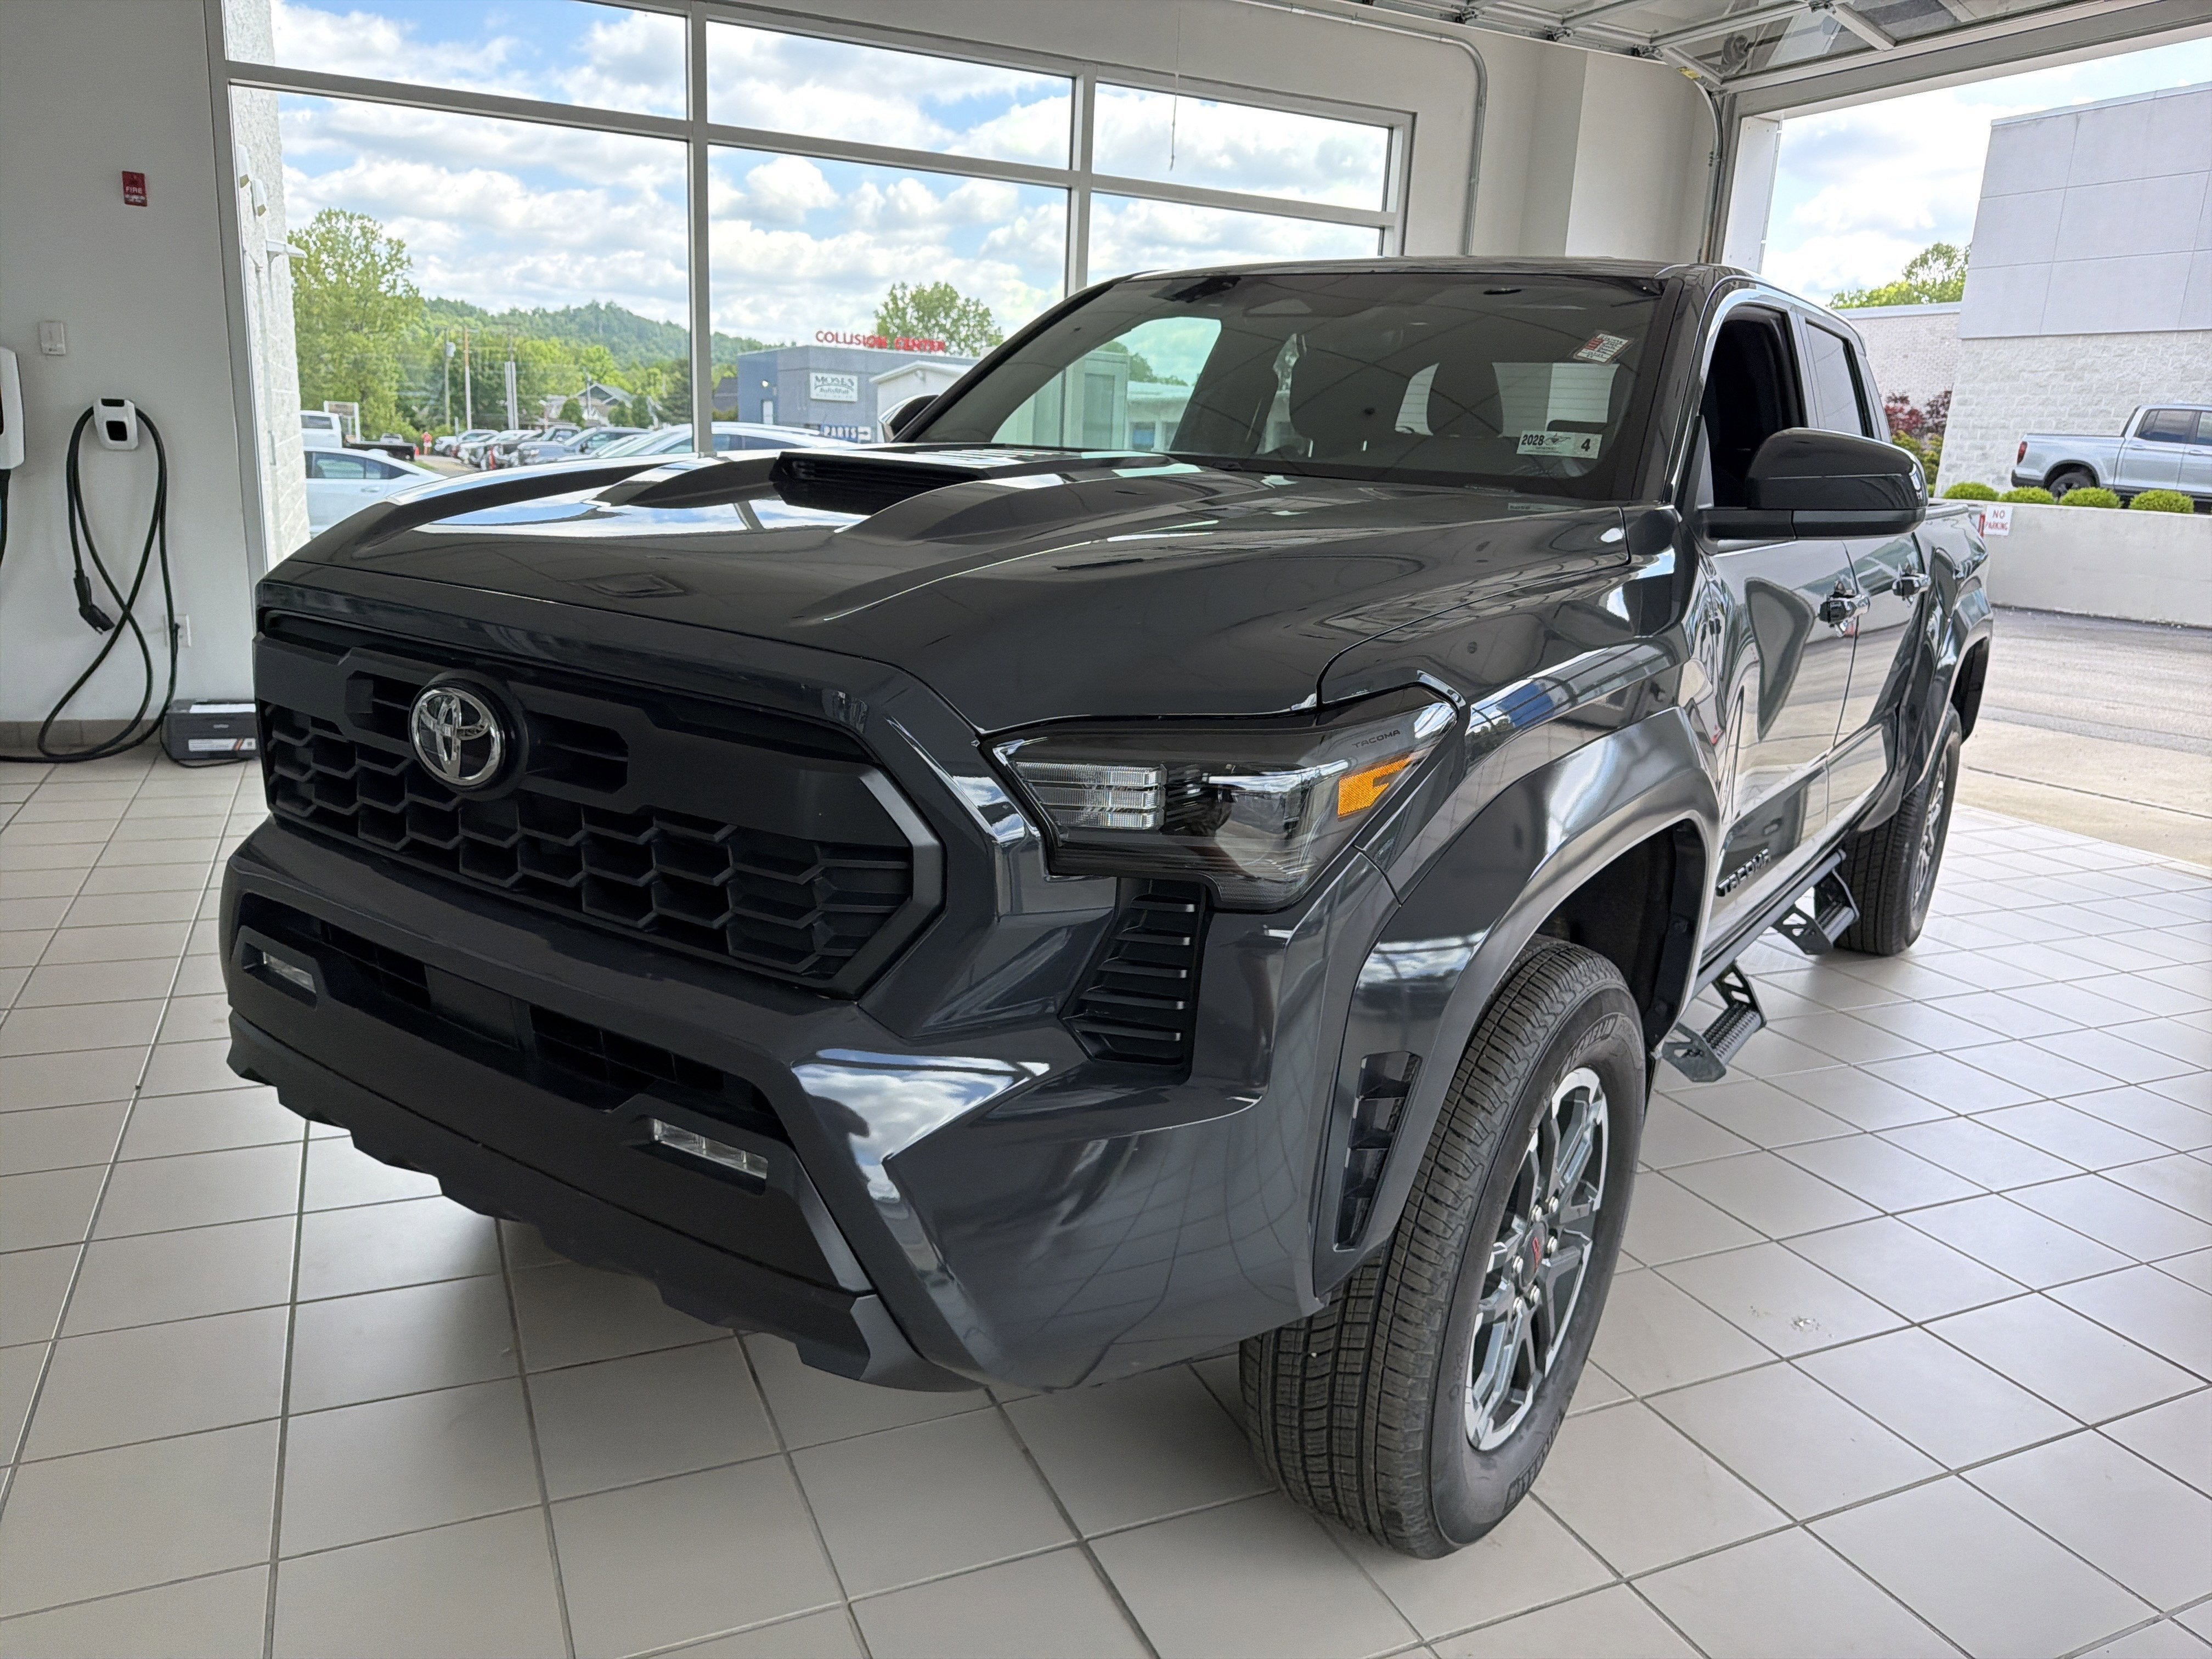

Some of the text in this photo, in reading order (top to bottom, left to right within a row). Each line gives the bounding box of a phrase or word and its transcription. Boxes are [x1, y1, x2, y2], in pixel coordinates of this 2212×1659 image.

[816, 330, 946, 352] COLLISION CENTER
[823, 426, 856, 439] PARTS
[1581, 438, 1591, 452] 4
[1992, 509, 2006, 519] NO
[1984, 521, 2008, 531] PARKING
[1352, 729, 1401, 748] TACOMA
